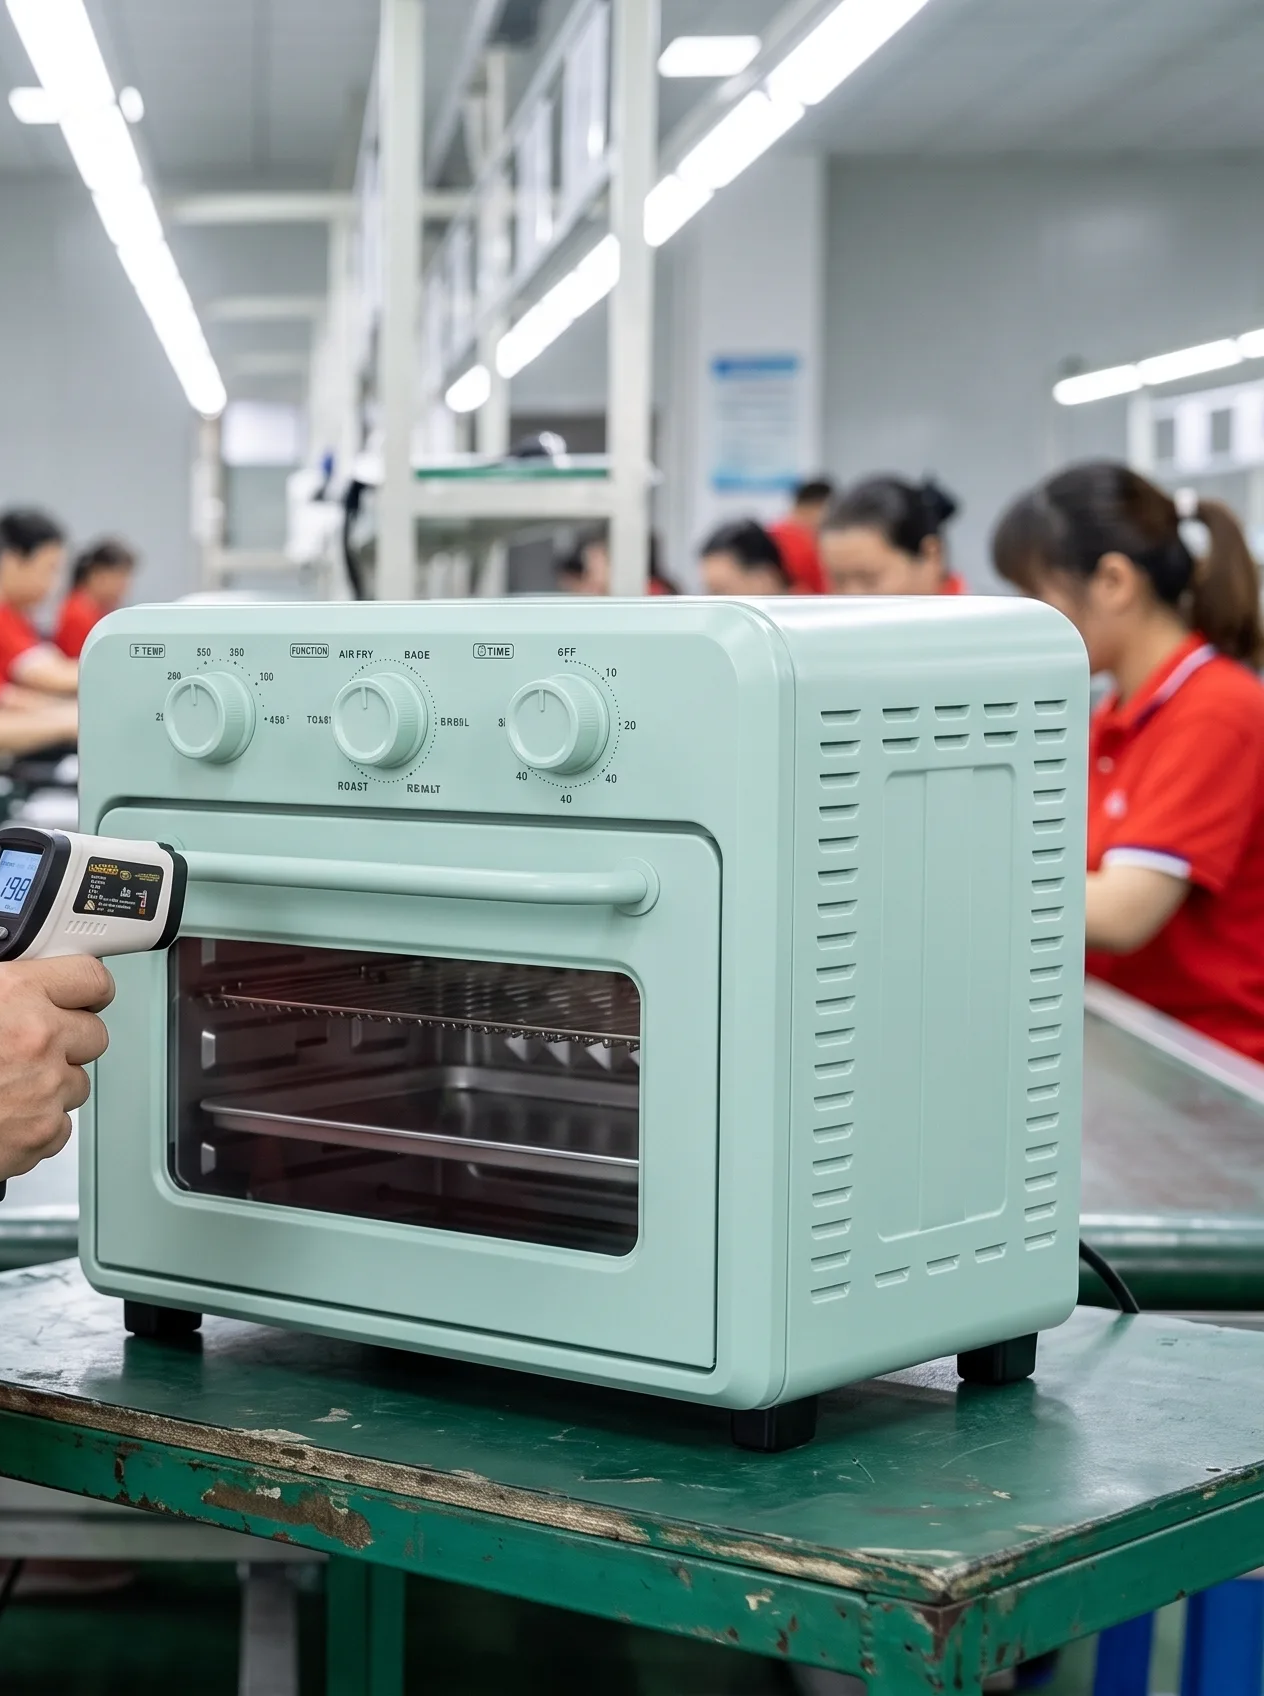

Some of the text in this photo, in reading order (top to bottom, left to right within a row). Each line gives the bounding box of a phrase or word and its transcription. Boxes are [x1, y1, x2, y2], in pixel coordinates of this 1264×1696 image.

[338, 650, 374, 659] AIR FRY
[487, 647, 510, 656] TIME
[606, 668, 617, 678] 10
[624, 720, 636, 731] 20
[515, 771, 528, 781] 40
[605, 773, 617, 784] 40
[337, 781, 368, 791] ROAST
[560, 794, 572, 804] 40
[0, 876, 32, 902] 198
